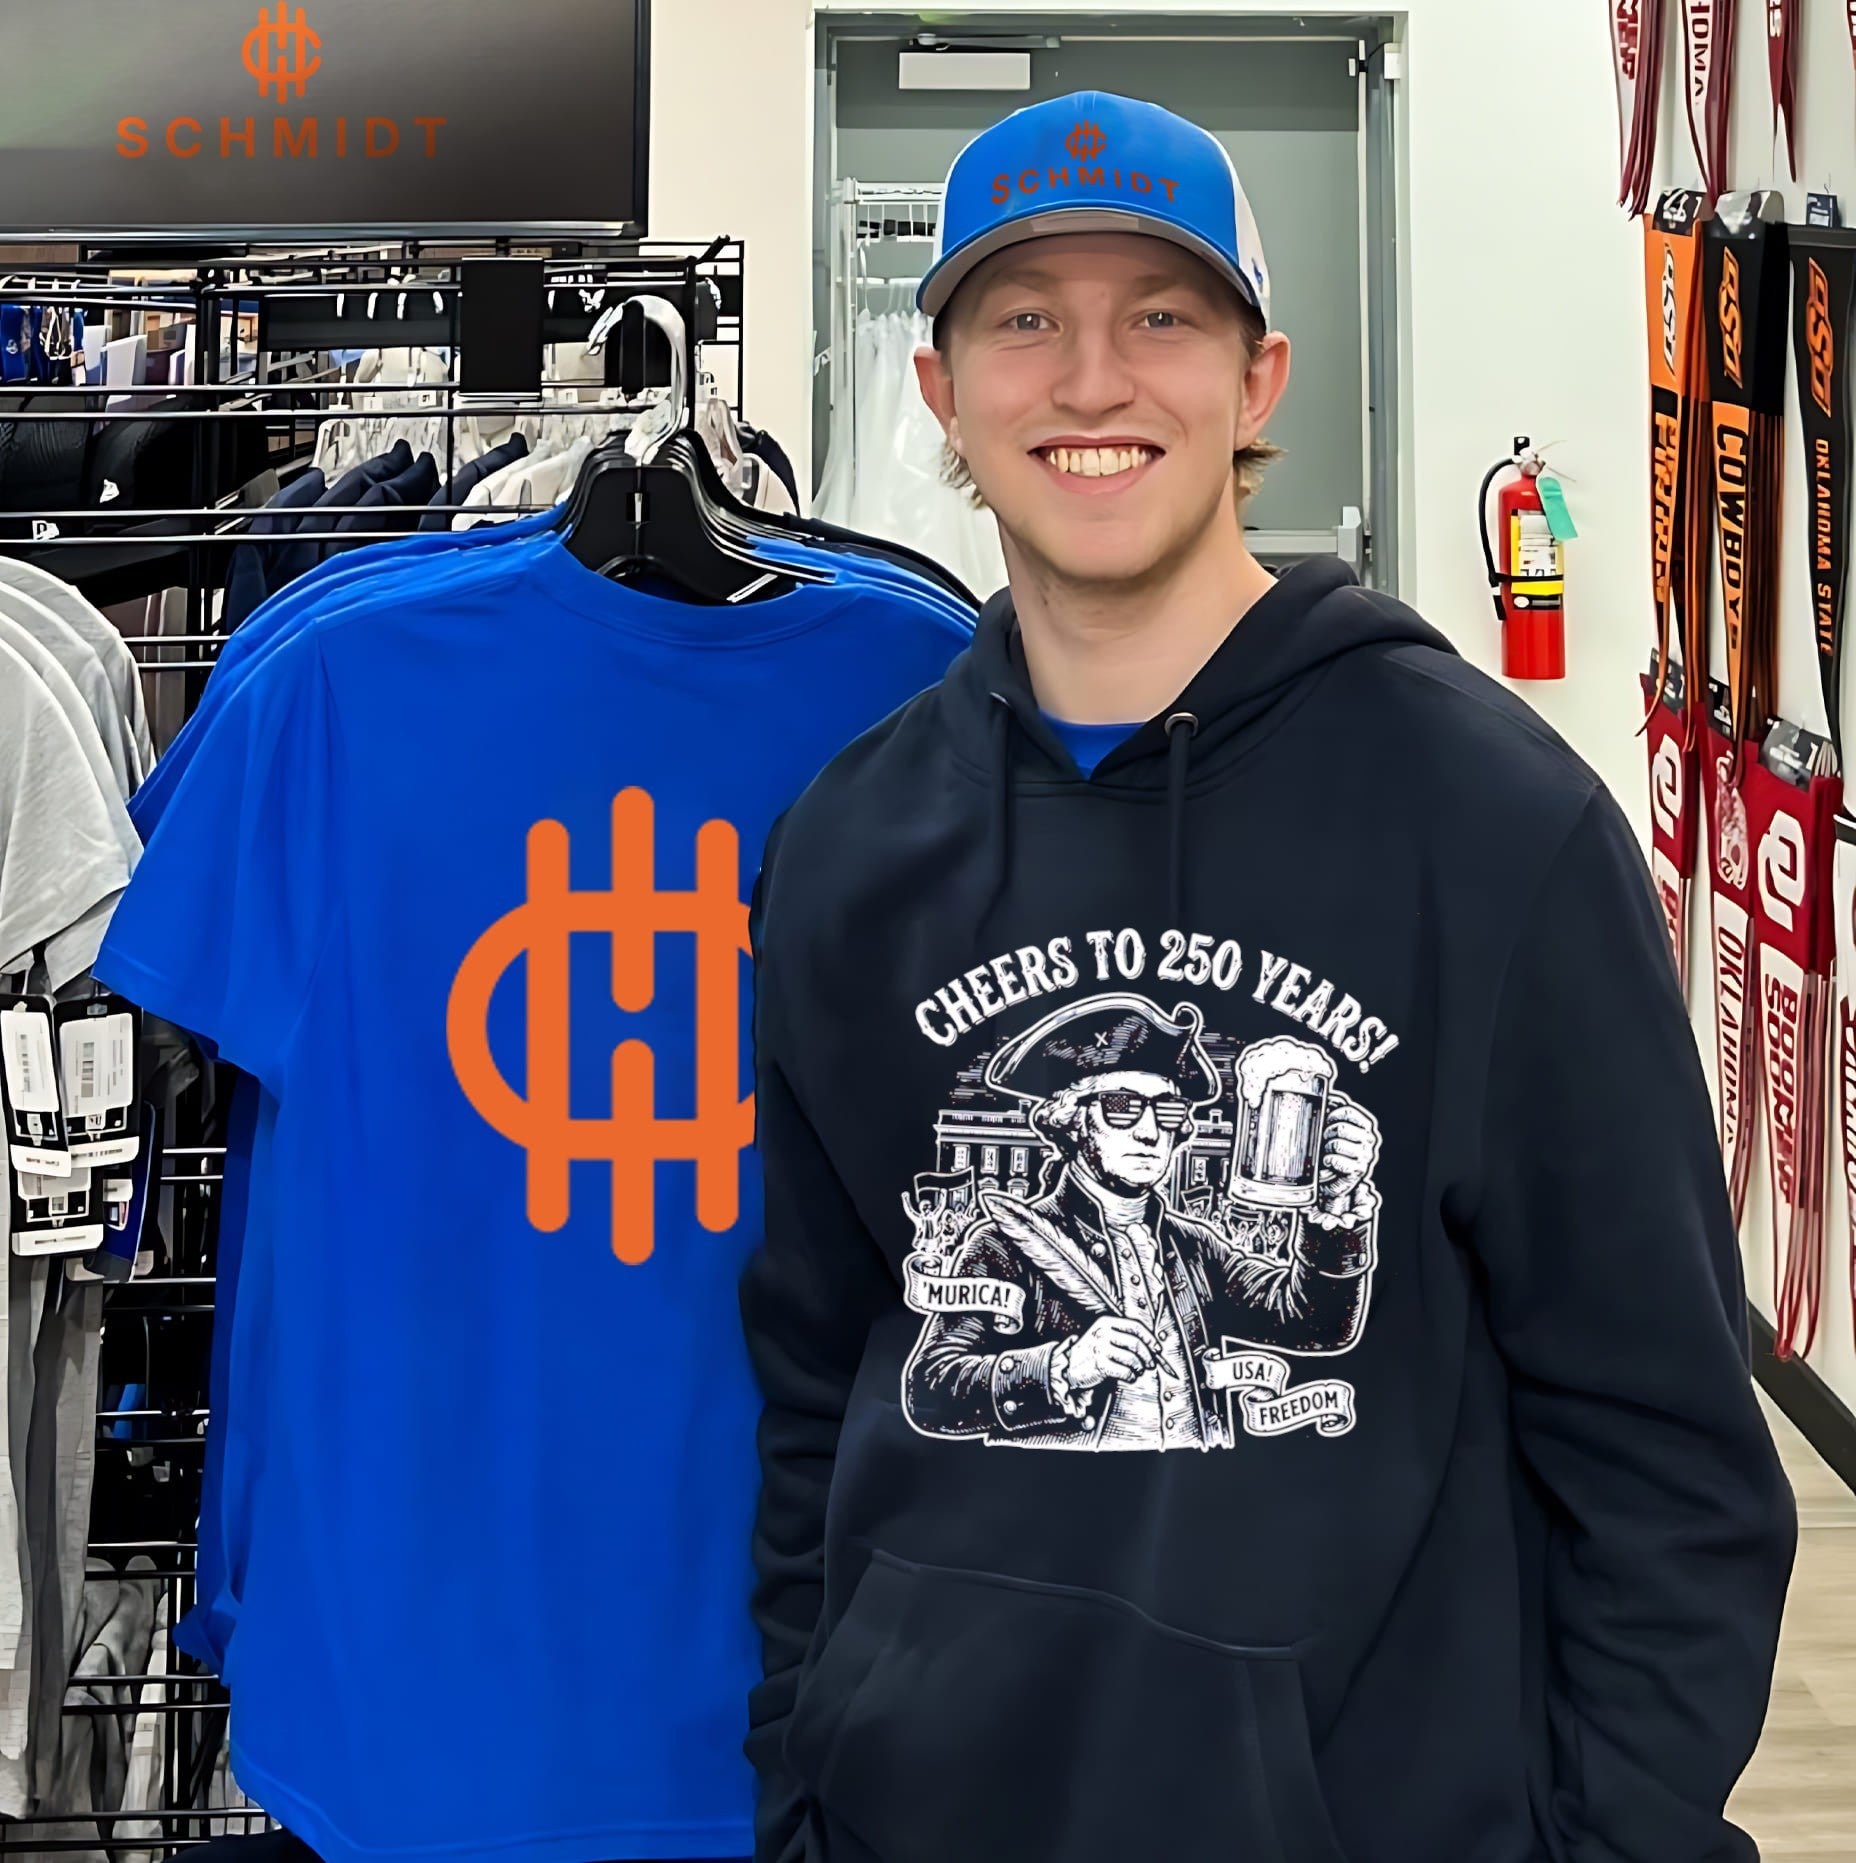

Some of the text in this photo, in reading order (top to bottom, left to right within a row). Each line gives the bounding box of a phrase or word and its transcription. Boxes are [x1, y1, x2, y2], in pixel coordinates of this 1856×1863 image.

[116, 116, 448, 159] SCHMIDT
[991, 166, 1180, 205] SCHMIDT
[915, 927, 1399, 1073] CHEERS TO 250 YEARS!
[923, 1281, 1011, 1308] 'MURICA!
[1232, 1361, 1273, 1382] USA!
[1260, 1390, 1338, 1426] FREEDOM
